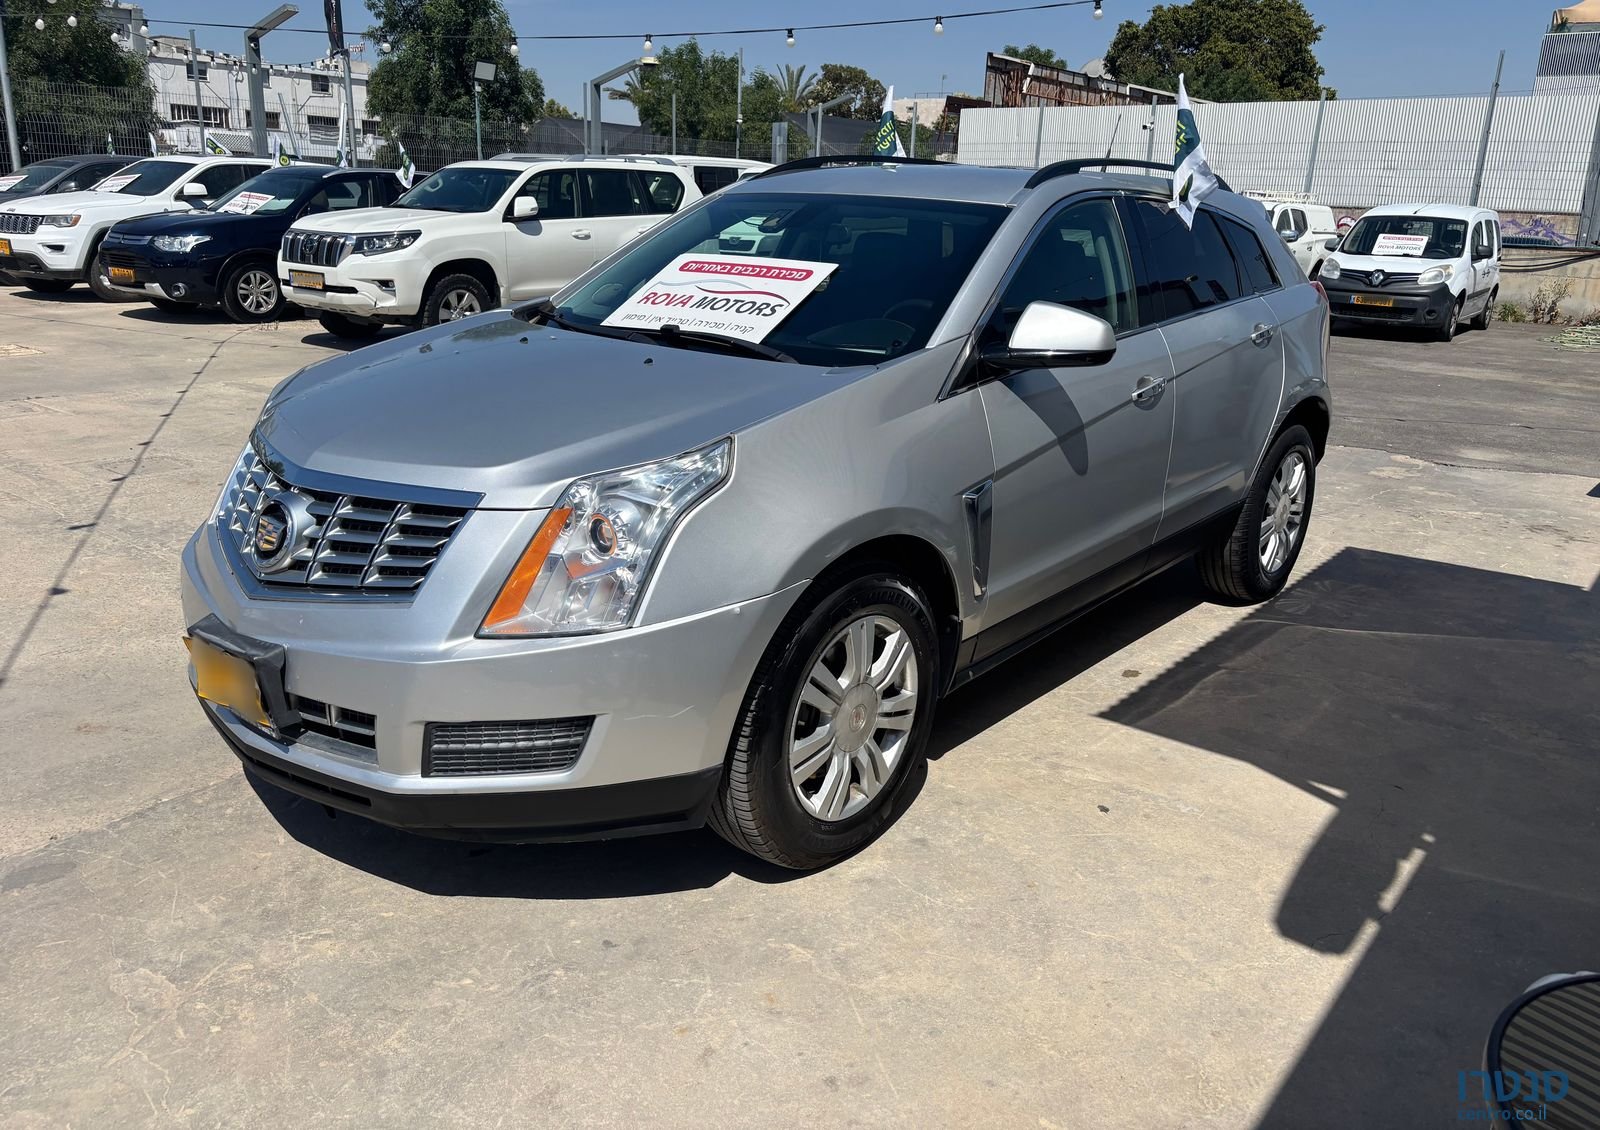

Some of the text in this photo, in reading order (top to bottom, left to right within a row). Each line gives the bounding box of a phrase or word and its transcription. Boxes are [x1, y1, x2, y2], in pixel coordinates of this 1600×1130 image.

[684, 263, 807, 279] מכירת רכבים באחריות
[637, 291, 784, 317] ROVA MOTORS
[621, 313, 646, 322] מימון
[694, 319, 725, 329] מכירה
[731, 324, 754, 335] קניה
